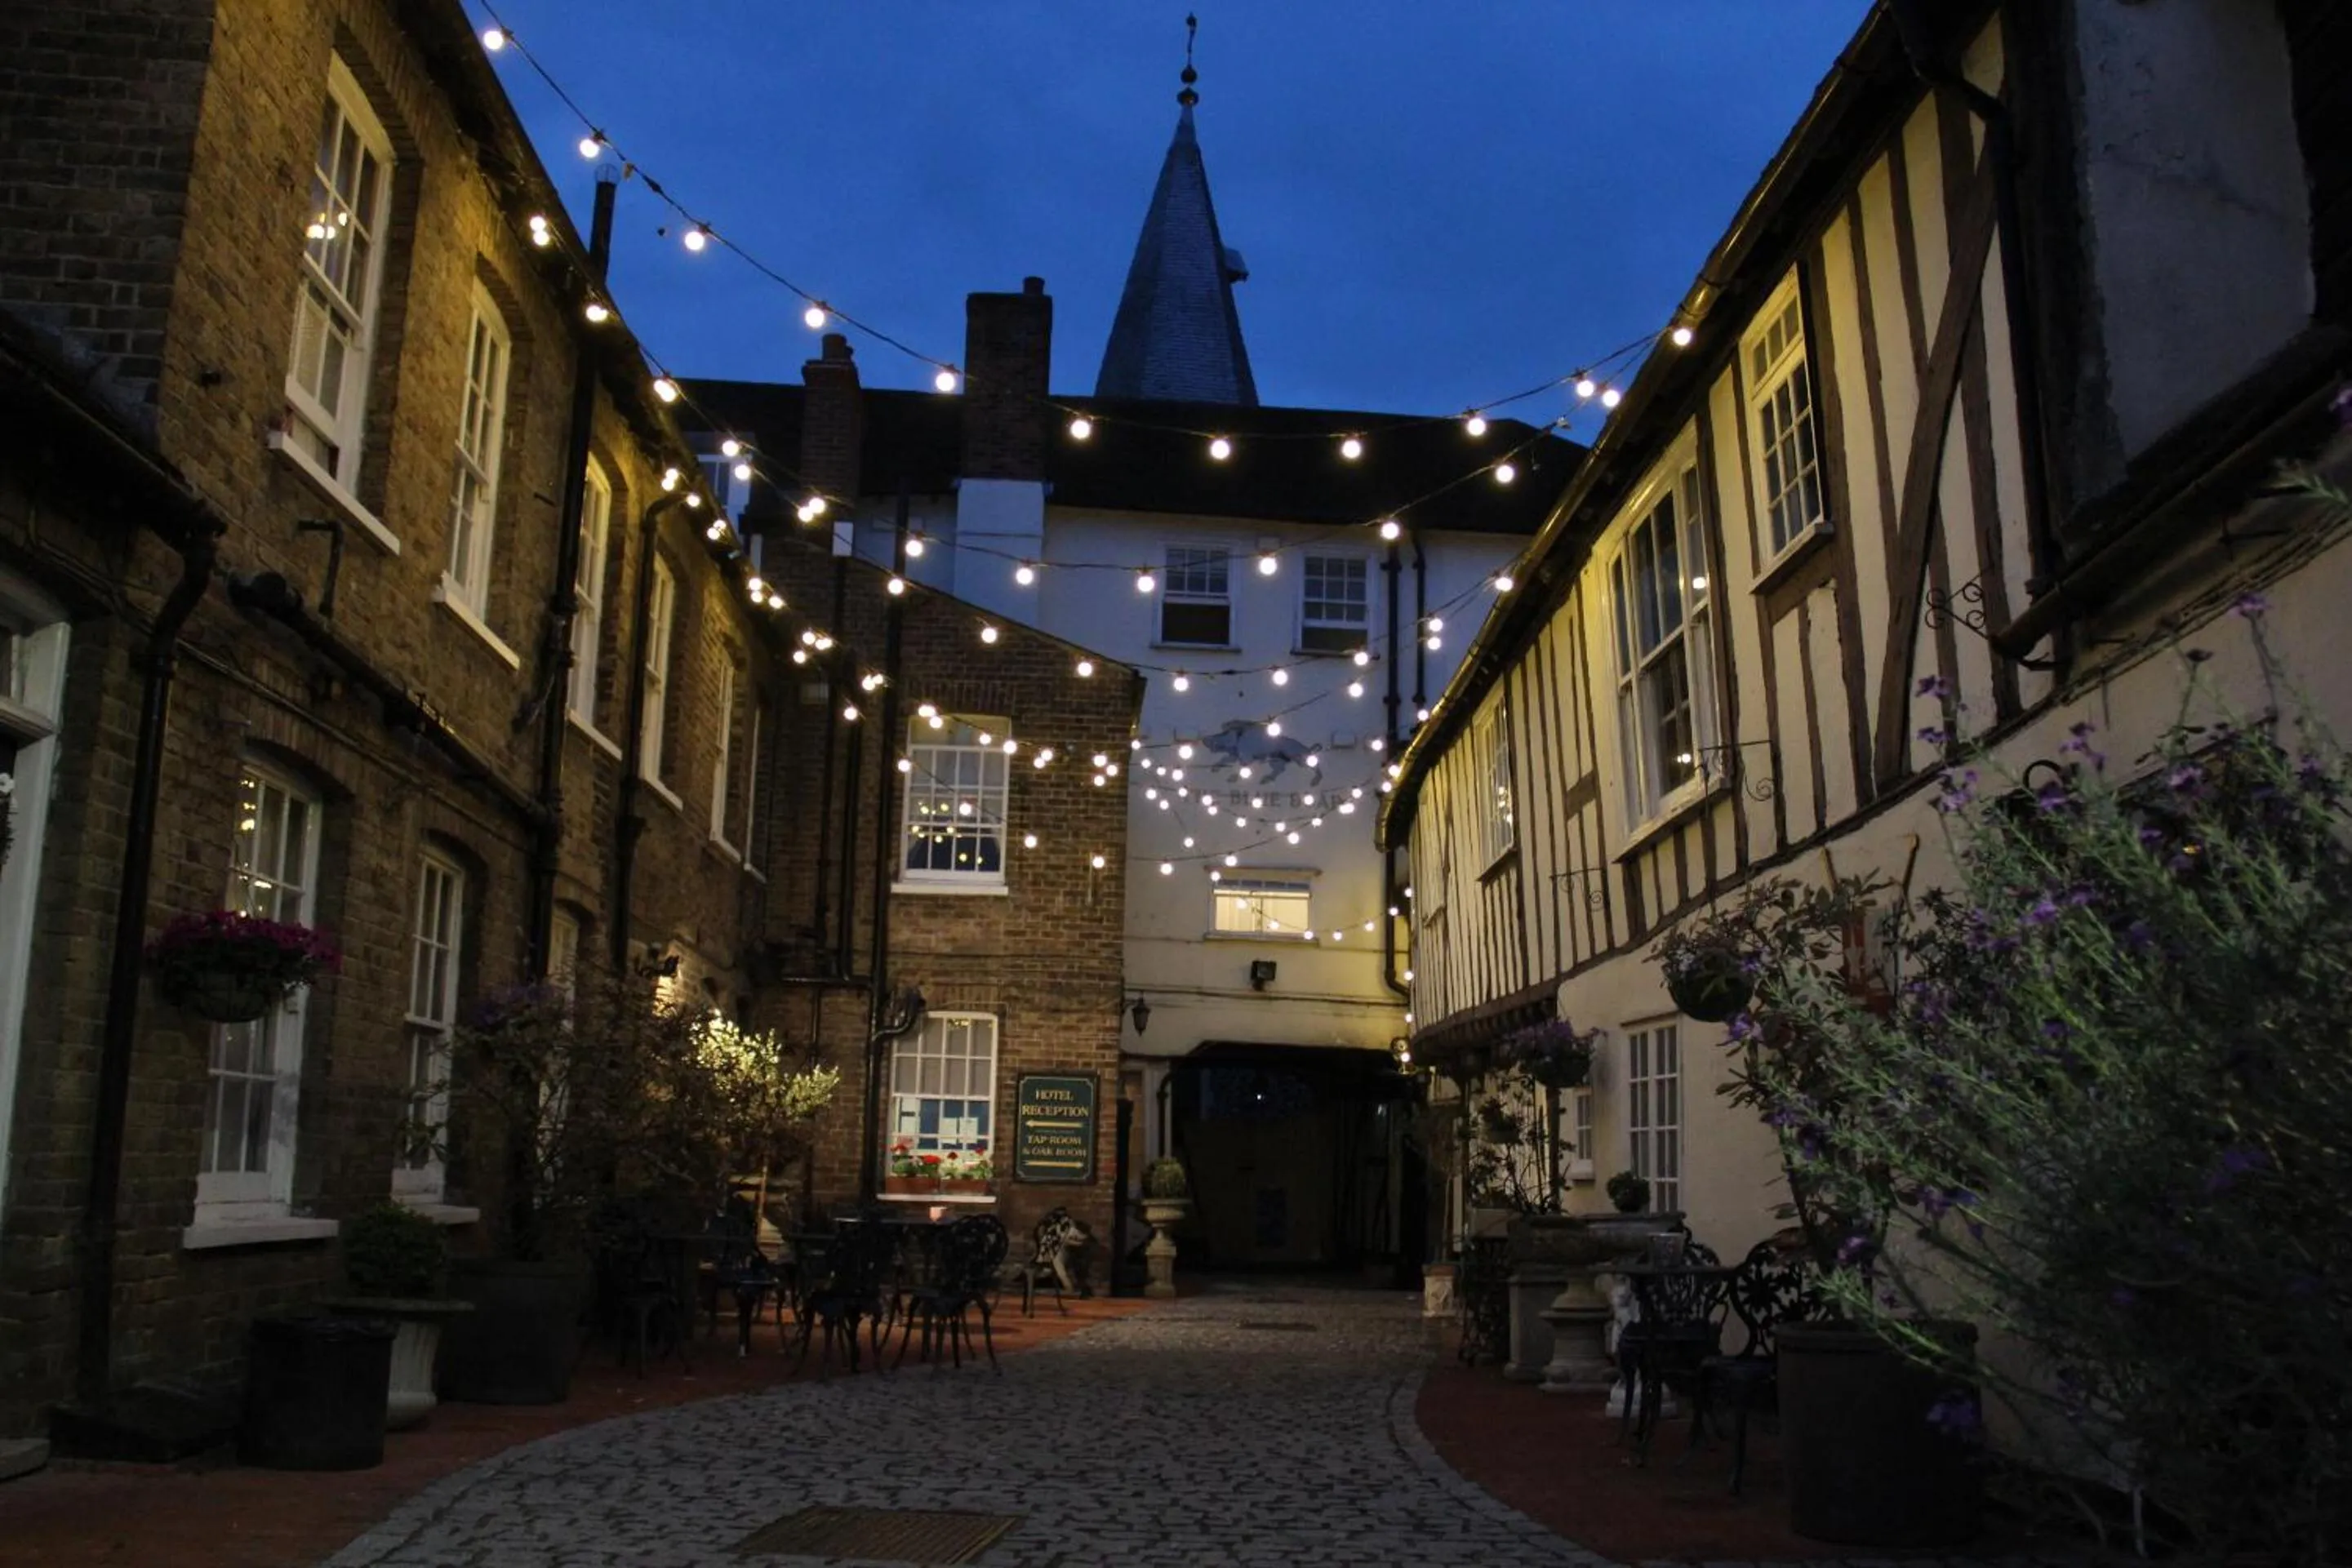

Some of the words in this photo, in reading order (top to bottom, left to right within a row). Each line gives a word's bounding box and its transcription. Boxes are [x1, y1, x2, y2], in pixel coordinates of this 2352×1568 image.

[1230, 790, 1281, 807] BLUE
[1290, 791, 1342, 810] BAR
[1036, 1089, 1074, 1100] HOTEL
[1022, 1104, 1089, 1117] RECEPTION
[1028, 1135, 1047, 1144] TAP
[1050, 1136, 1082, 1145] ROOM
[1056, 1148, 1087, 1157] ROOM
